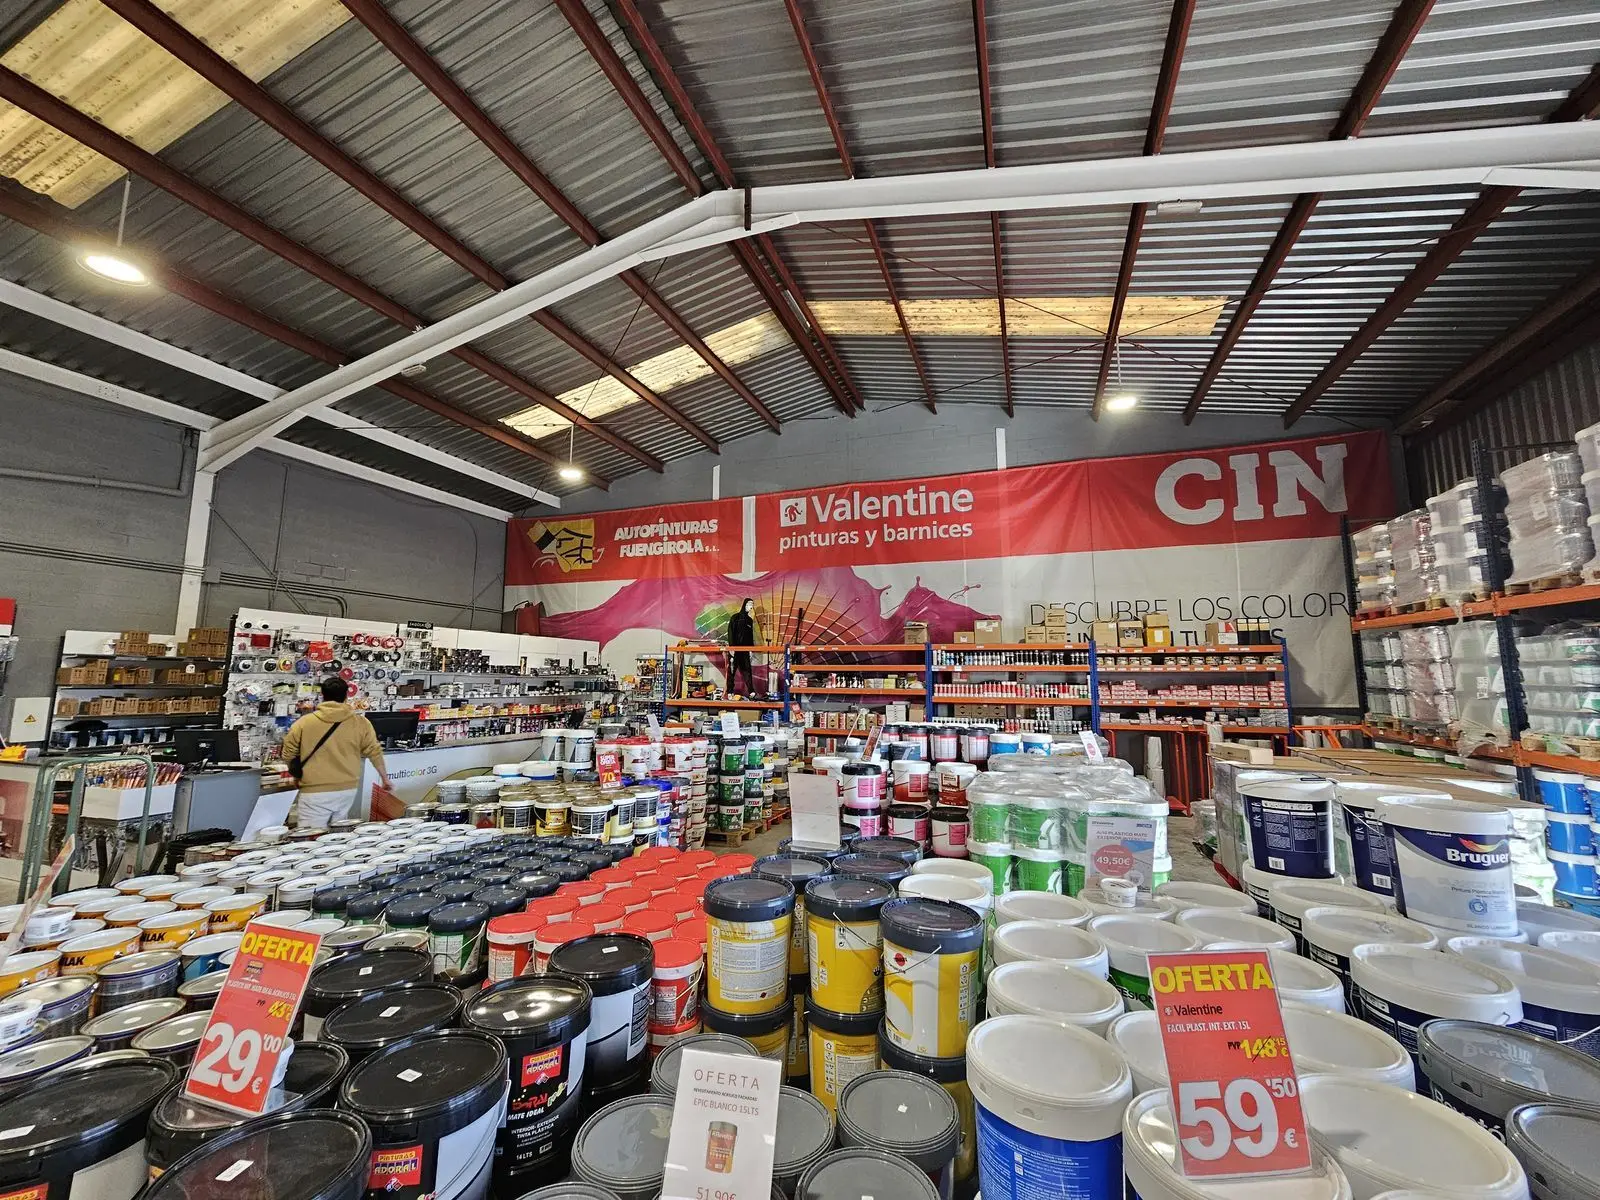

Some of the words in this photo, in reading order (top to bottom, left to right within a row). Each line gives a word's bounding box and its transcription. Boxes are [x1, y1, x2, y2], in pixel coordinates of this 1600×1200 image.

[1154, 443, 1348, 525] CIN
[811, 486, 974, 522] Valentine
[614, 517, 718, 540] AUTOPINTURAS
[779, 529, 859, 553] pinturas
[865, 529, 877, 547] y
[883, 521, 973, 542] barnices
[620, 536, 704, 557] FUENGIROLA
[1030, 599, 1167, 625] DSCUBRE
[1178, 597, 1233, 622] LOS
[1241, 593, 1350, 619] COLOR
[426, 765, 437, 775] 3G
[1096, 856, 1130, 866] 49,50€
[1446, 848, 1509, 866] Bruguer
[240, 932, 315, 966] OFERTA
[1153, 963, 1275, 994] OFERTA
[1174, 1004, 1223, 1016] Valentine
[1167, 1024, 1186, 1033] FACIL
[1186, 1022, 1209, 1032] PLAST.
[1209, 1022, 1223, 1031] INT.
[1223, 1021, 1238, 1031] EXT.
[1239, 1021, 1251, 1030] 15L
[1227, 1041, 1241, 1050] PVP
[251, 1076, 263, 1094] €
[694, 1069, 760, 1091] OFERTA
[507, 1112, 525, 1121] MATE
[526, 1107, 545, 1117] IDEAL
[693, 1097, 709, 1109] EPIC
[709, 1100, 737, 1112] BLANCO
[739, 1105, 759, 1116] 15LTS
[1178, 1078, 1279, 1161] 59
[1284, 1127, 1299, 1149] €
[379, 1151, 415, 1162] PINTURAS
[374, 1161, 417, 1175] ADORAL
